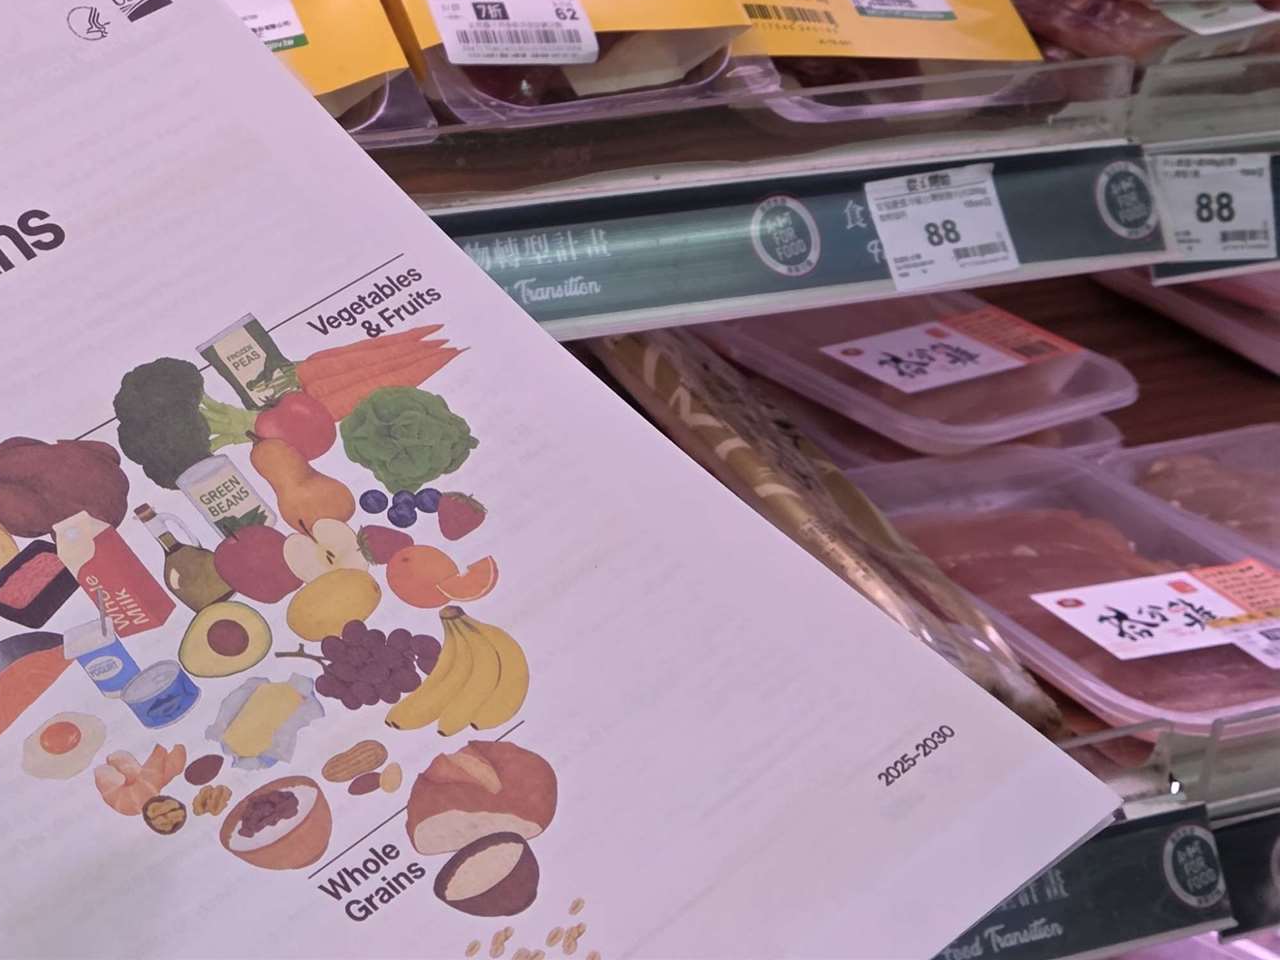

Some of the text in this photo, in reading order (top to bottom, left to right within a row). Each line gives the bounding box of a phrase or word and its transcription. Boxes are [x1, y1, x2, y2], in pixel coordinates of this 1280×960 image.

[554, 7, 580, 21] 62
[1195, 192, 1236, 223] 88
[924, 219, 961, 247] 88
[306, 266, 423, 337] Vegetables
[513, 275, 602, 305] Transition
[361, 285, 443, 339] & Fruits
[226, 343, 254, 362] FROZEN
[231, 350, 262, 371] PEAS
[199, 475, 242, 506] GREEN
[207, 485, 251, 518] BEANS
[114, 587, 151, 625] Milk
[317, 843, 401, 902] Whole
[344, 861, 427, 922] Grains
[984, 917, 1065, 954] Transition
